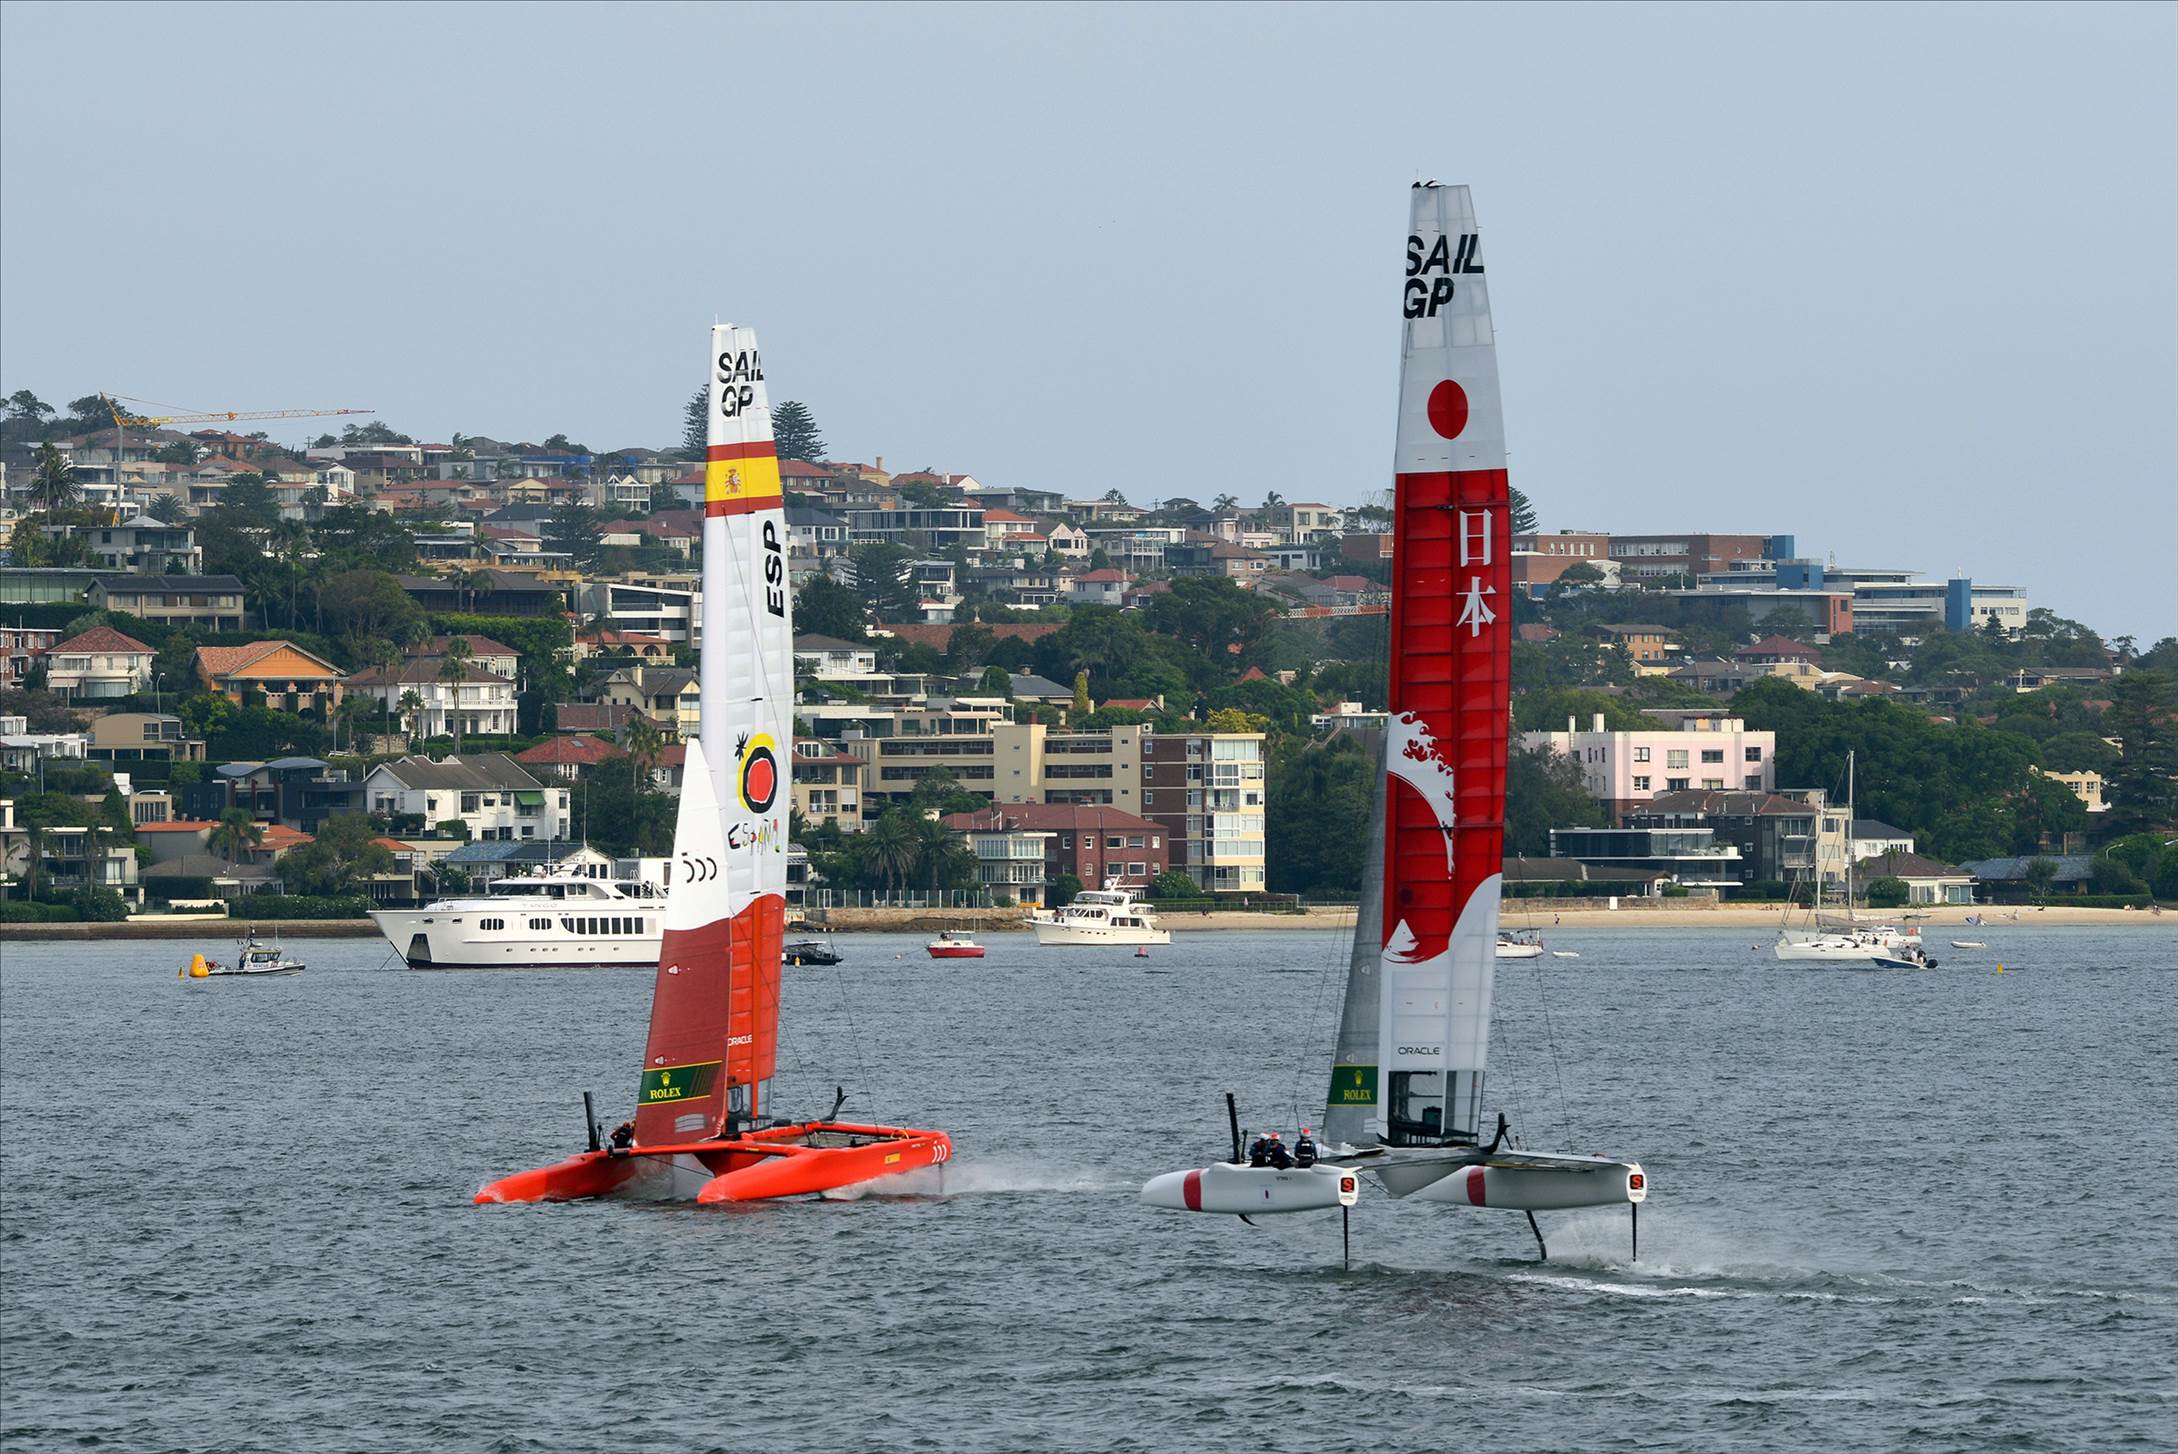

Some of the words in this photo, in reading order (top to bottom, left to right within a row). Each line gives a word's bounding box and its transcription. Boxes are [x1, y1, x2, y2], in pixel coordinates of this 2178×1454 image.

[1405, 234, 1484, 277] SAIL
[1403, 277, 1455, 319] GP
[717, 350, 765, 384] SAIL
[721, 385, 754, 417] GP
[763, 519, 785, 619] ESP
[1456, 508, 1497, 637] 日本
[728, 1034, 753, 1047] ORACLE
[1398, 1046, 1440, 1056] ORACLE
[650, 1086, 682, 1100] ROLEX
[1343, 1089, 1371, 1101] ROLEX
